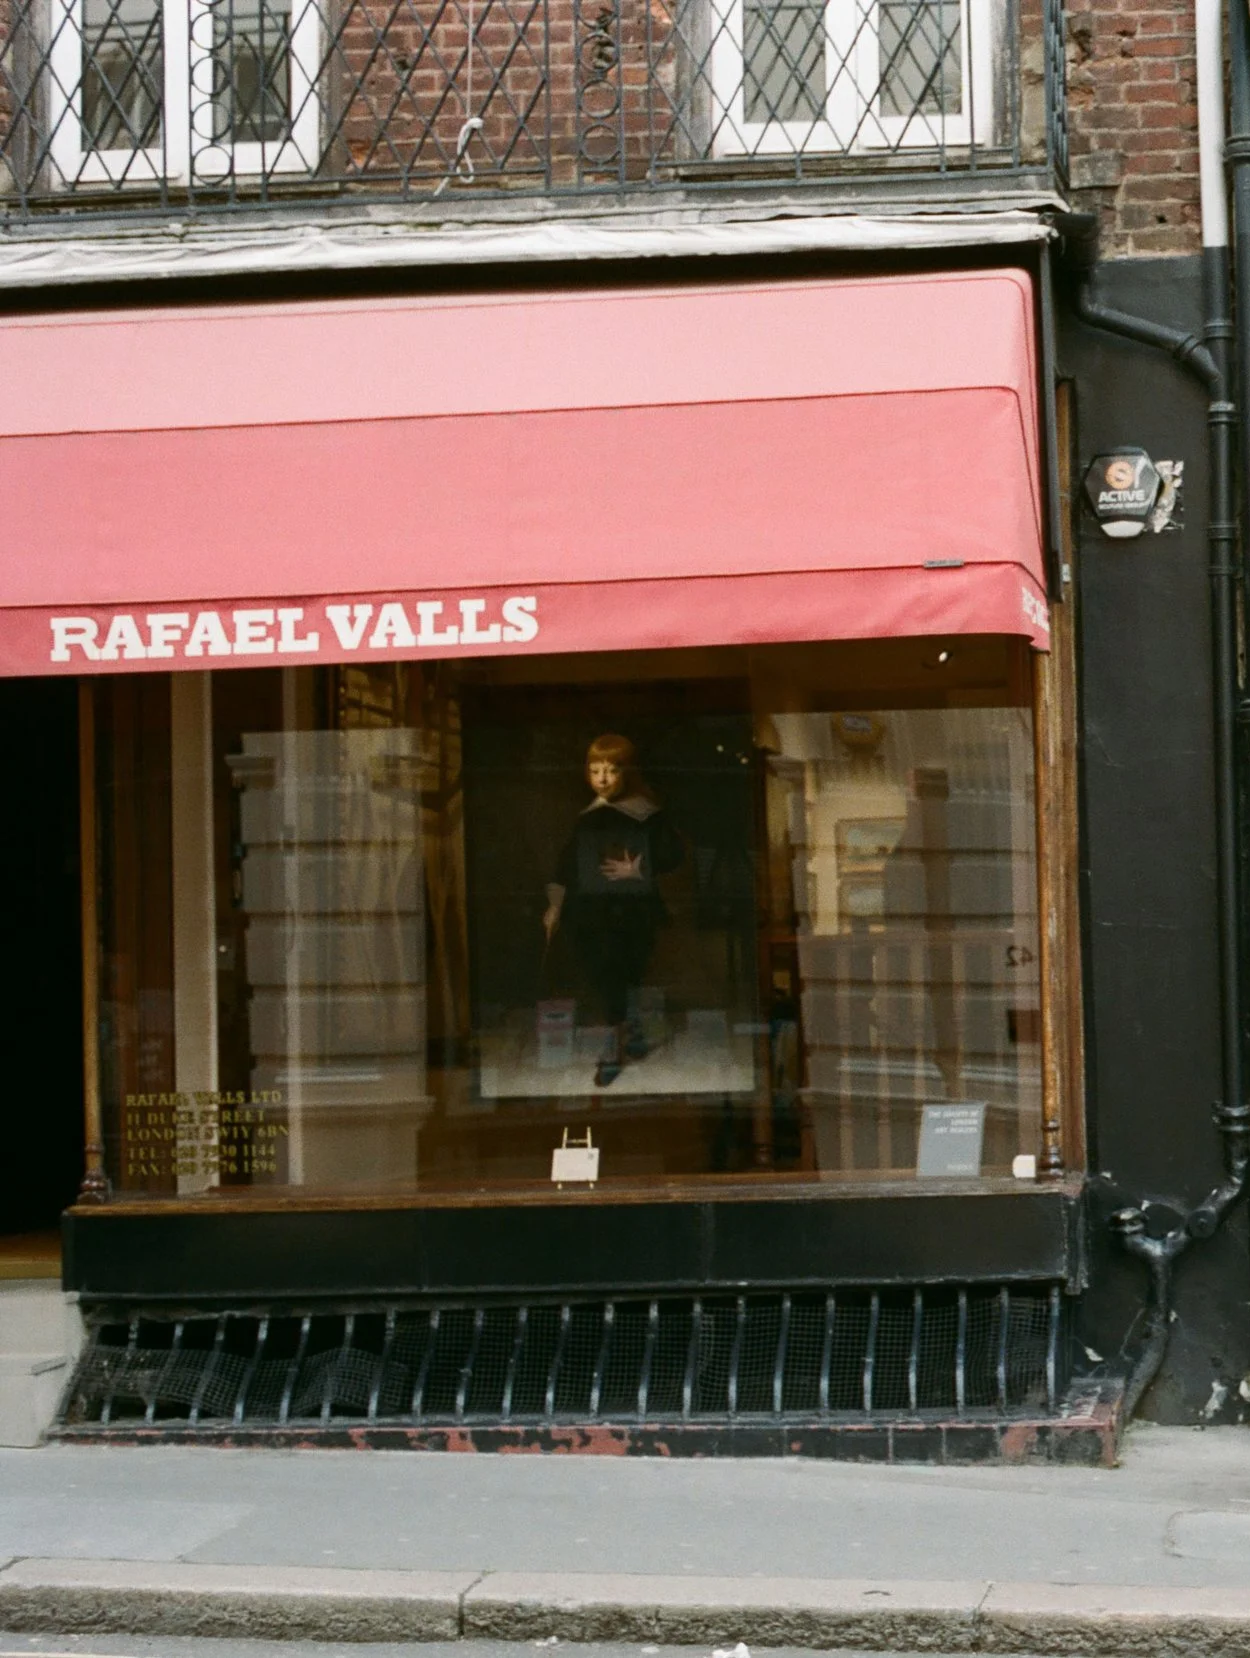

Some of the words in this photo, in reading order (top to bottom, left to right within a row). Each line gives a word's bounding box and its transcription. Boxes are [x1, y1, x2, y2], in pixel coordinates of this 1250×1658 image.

[1099, 489, 1145, 502] ACTIVE
[50, 607, 319, 662] RAFAEL
[326, 596, 539, 650] VALLS
[252, 1090, 282, 1104] LTD
